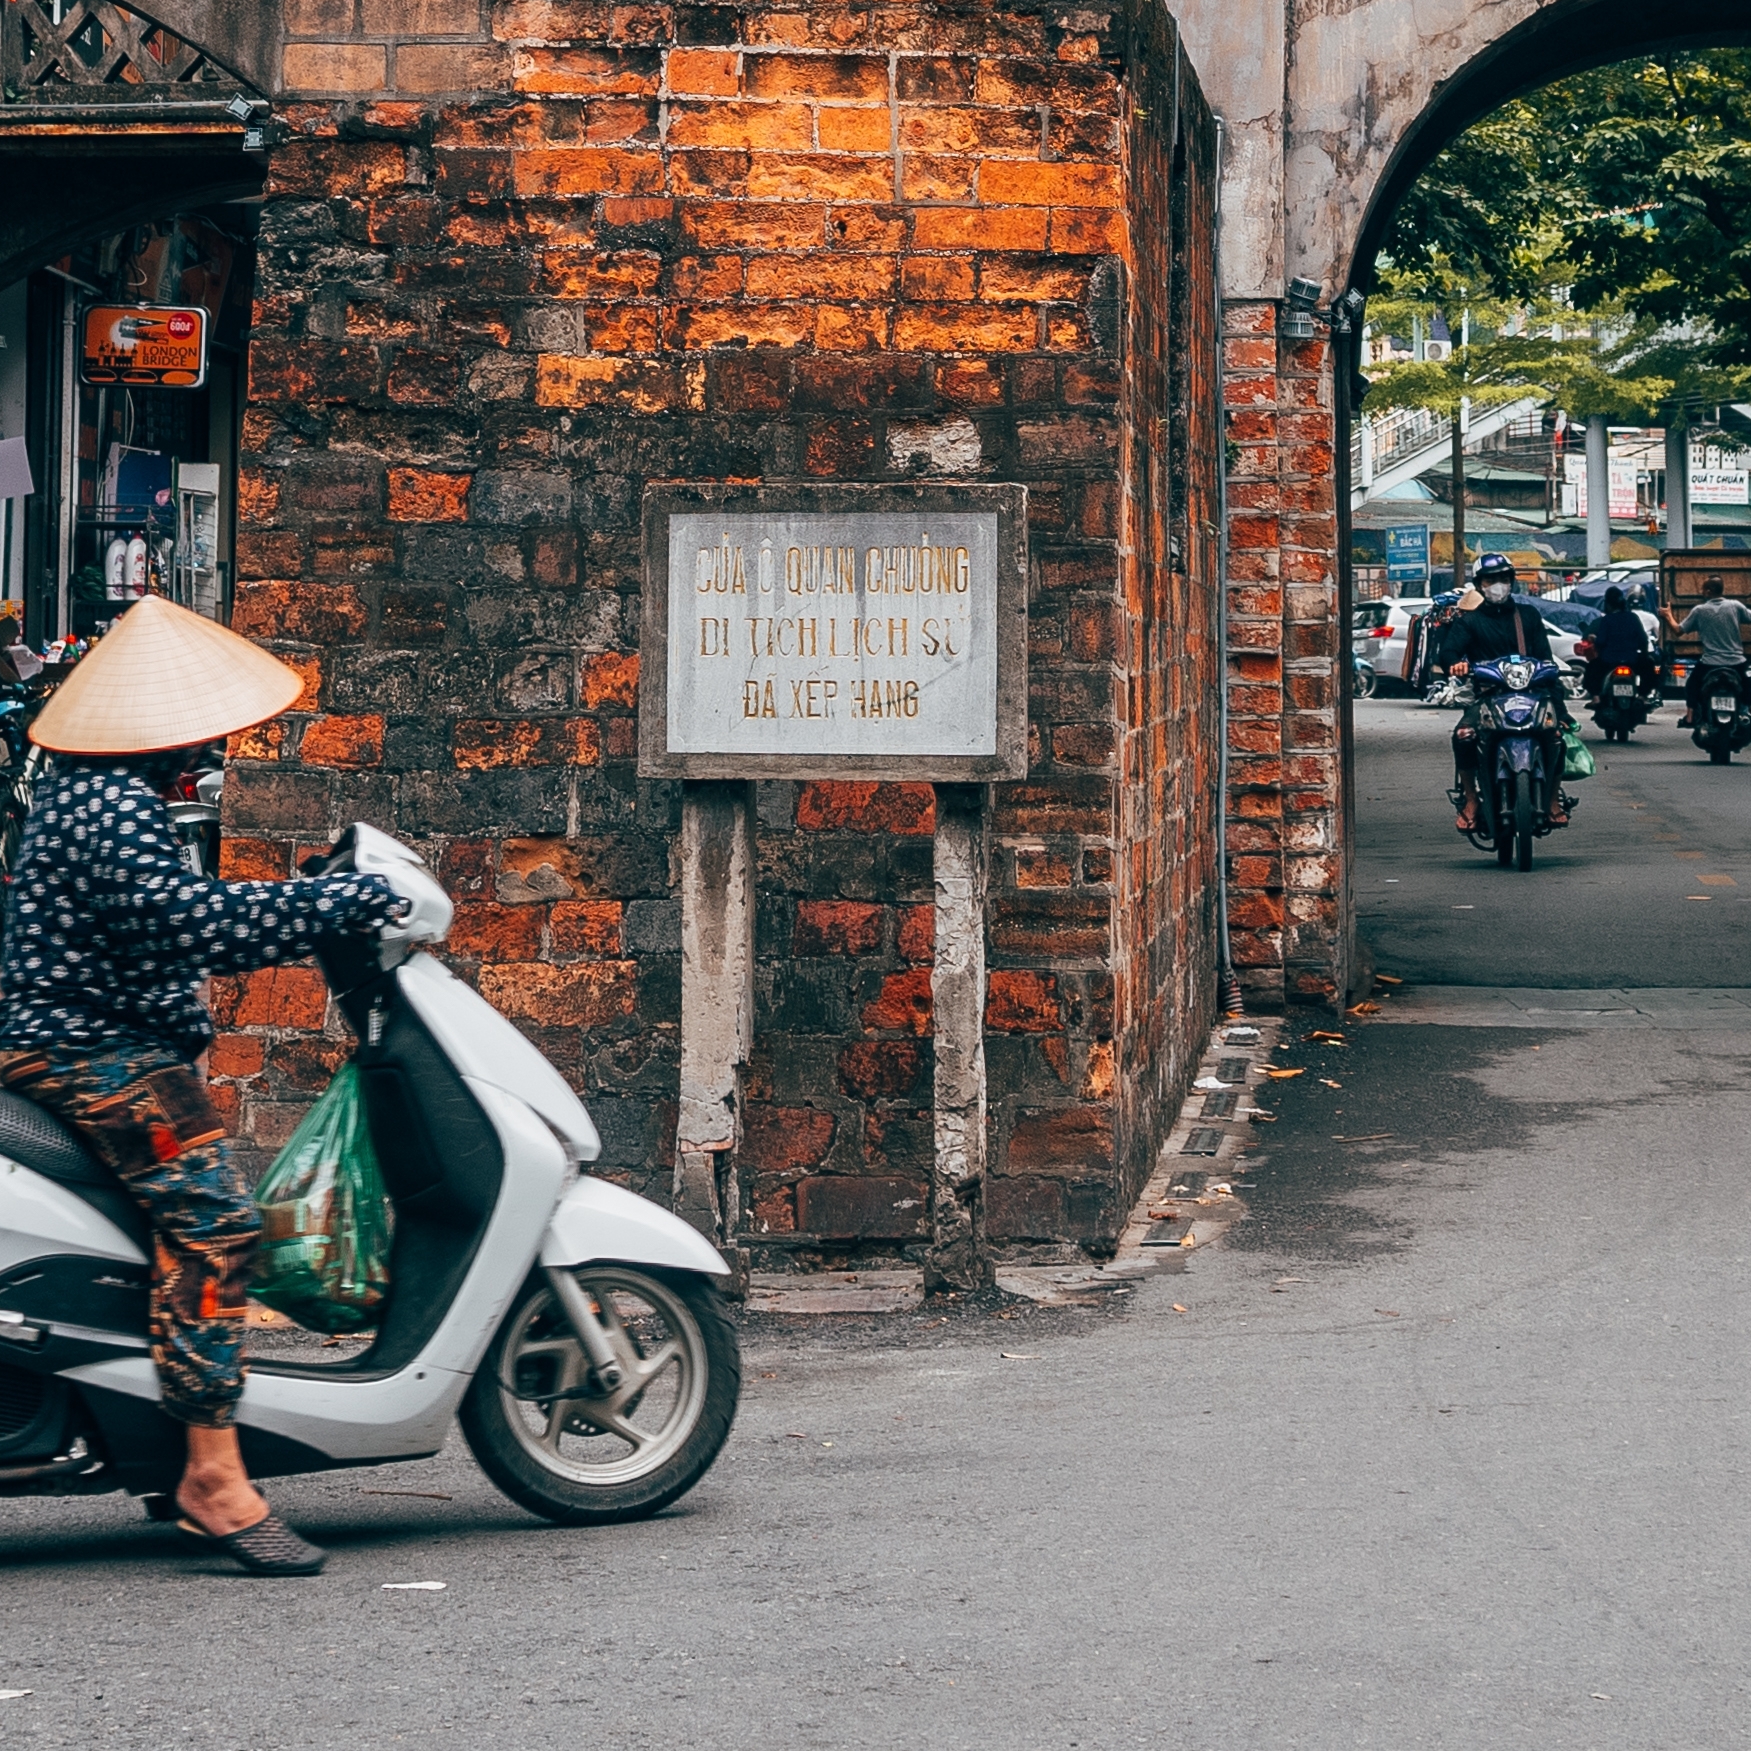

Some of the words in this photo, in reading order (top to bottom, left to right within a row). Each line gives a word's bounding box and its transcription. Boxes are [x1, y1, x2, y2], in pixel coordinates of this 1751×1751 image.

[142, 345, 197, 357] LONDON
[142, 355, 187, 367] BRIDGE
[786, 546, 855, 596] QUAN
[699, 617, 730, 657] DI
[828, 617, 909, 663] LỊCH
[742, 672, 778, 719] ĐÃ
[788, 665, 840, 720] XẾP
[850, 679, 920, 726] HẠNG
